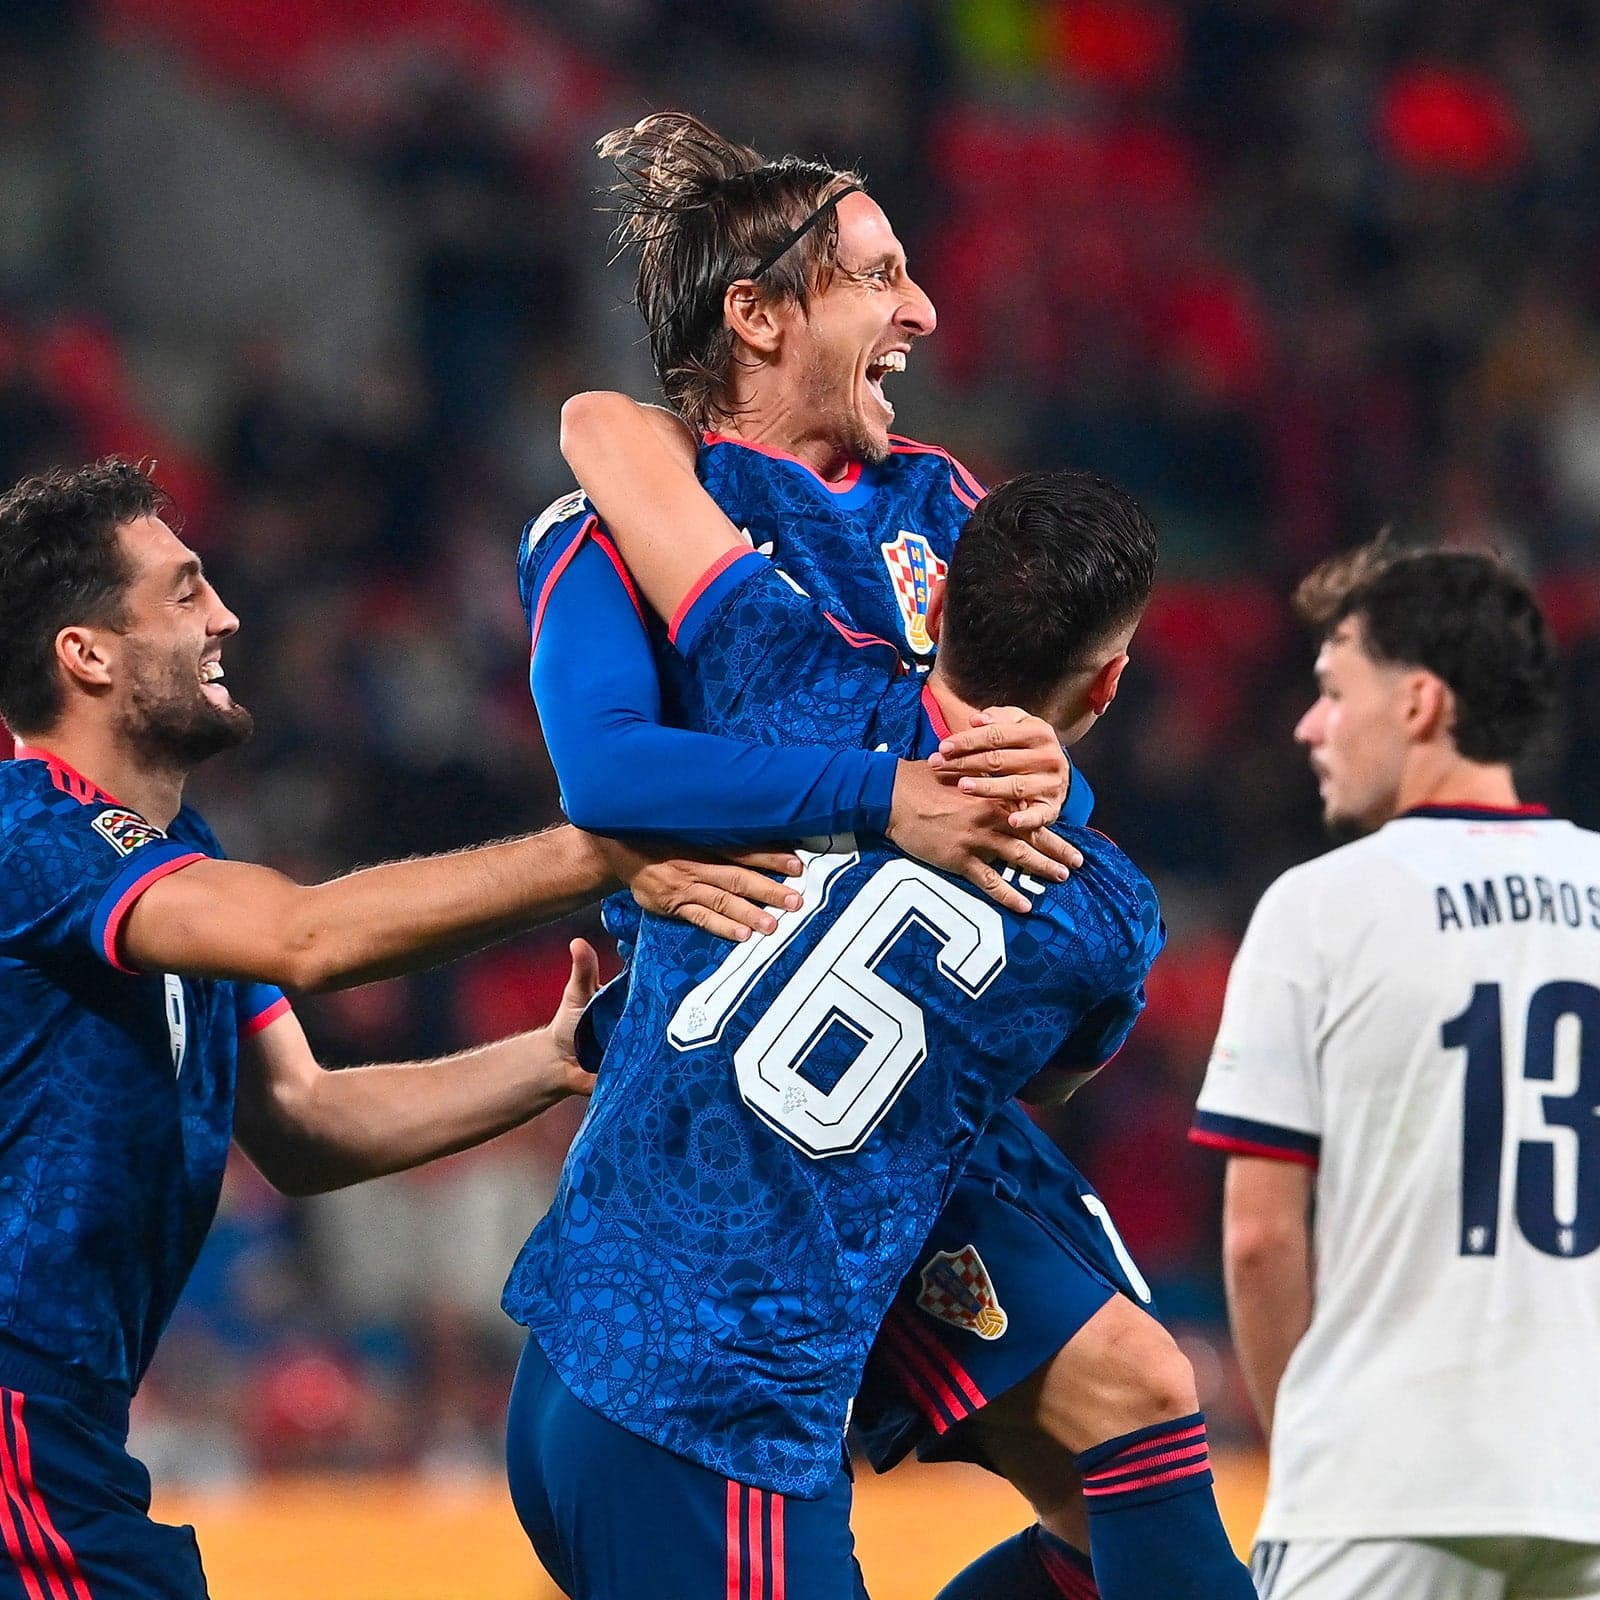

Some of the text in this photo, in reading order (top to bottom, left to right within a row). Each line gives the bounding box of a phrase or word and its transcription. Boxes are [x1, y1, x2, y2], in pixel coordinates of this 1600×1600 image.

[910, 546, 926, 602] HNS
[1436, 874, 1600, 931] AMBROS
[666, 831, 1006, 1160] 16
[1441, 980, 1600, 1257] 13
